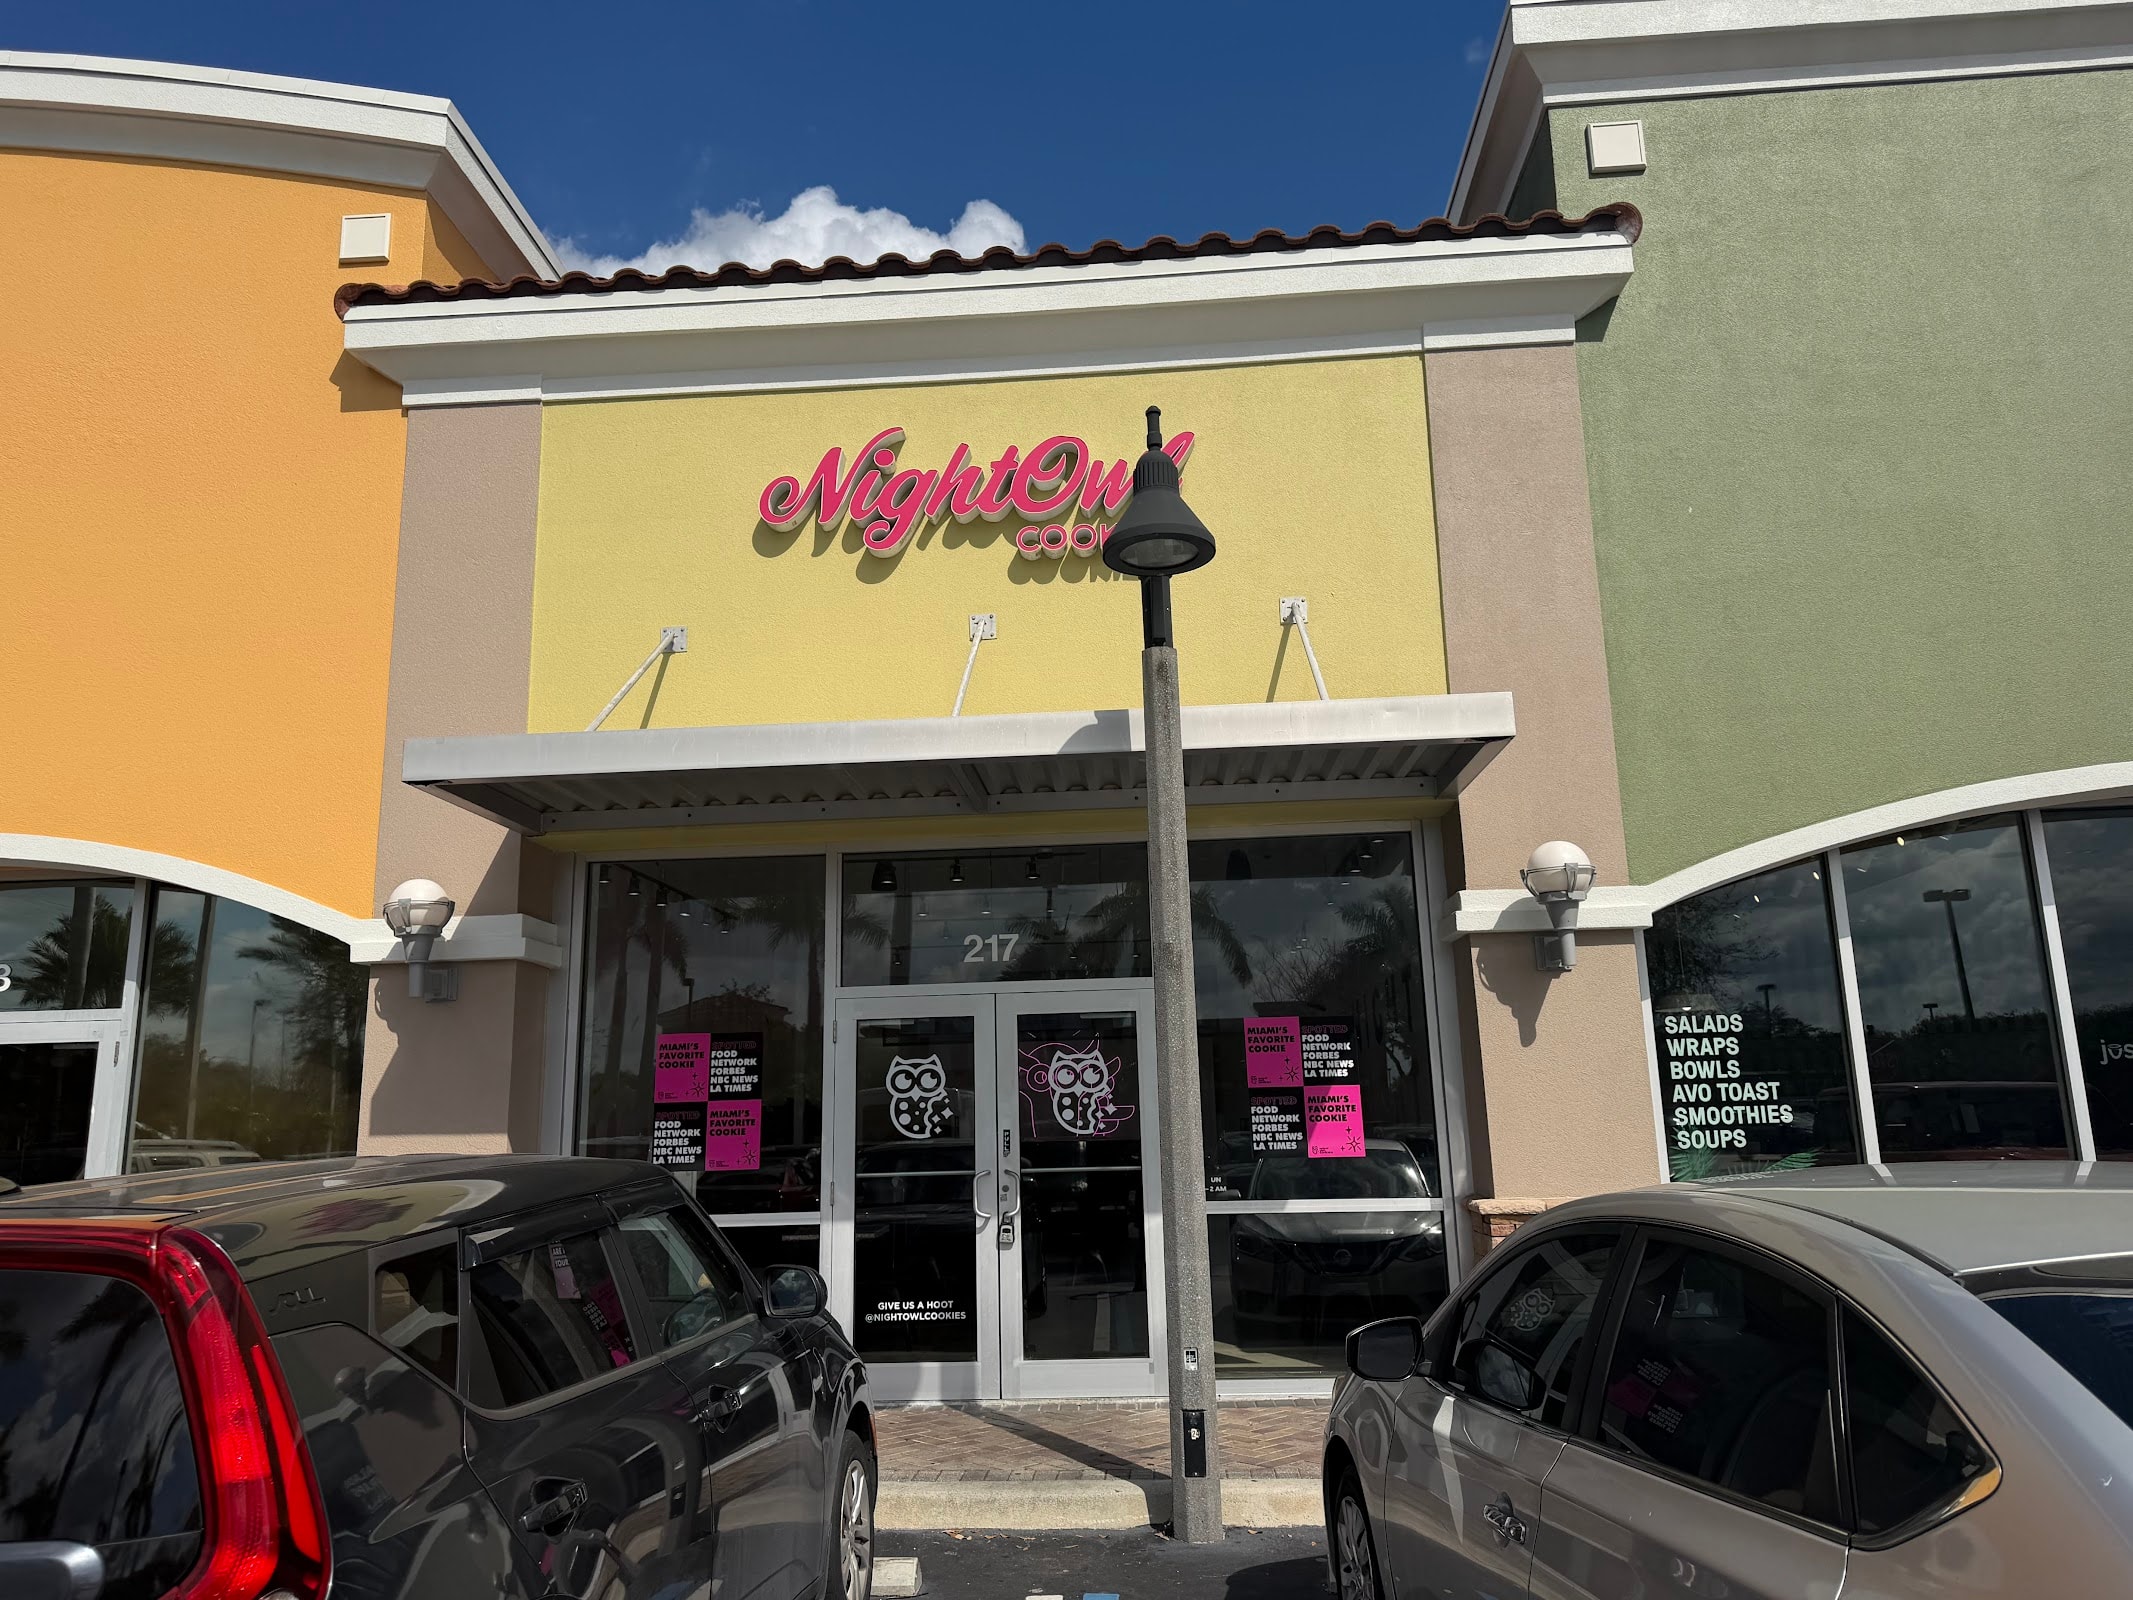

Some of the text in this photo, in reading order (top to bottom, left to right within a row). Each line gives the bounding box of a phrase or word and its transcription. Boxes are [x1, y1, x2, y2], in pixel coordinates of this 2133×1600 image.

[963, 933, 1019, 963] 217
[1665, 1014, 1743, 1034] SALADS
[1302, 1042, 1351, 1050] NETWORK
[1666, 1037, 1739, 1056] WRAPS
[1303, 1052, 1340, 1060] FORBES
[711, 1058, 757, 1066] NETWORK
[1327, 1060, 1354, 1068] NEWS
[711, 1067, 745, 1075] FORBES
[1670, 1060, 1740, 1079] BOWLS
[1673, 1082, 1780, 1102] AVO TOAST
[1309, 1105, 1356, 1113] FAVORITE
[1252, 1114, 1300, 1123] NETWORK
[1309, 1114, 1347, 1122] COOKIE
[1675, 1105, 1793, 1126] SMOOTHIES
[1252, 1124, 1288, 1132] FORBES
[654, 1129, 700, 1137] NETWORK
[1276, 1132, 1303, 1140] NEWS
[654, 1138, 689, 1146] FORBES
[1678, 1129, 1747, 1149] SOUPS
[1268, 1141, 1297, 1150] TIMES
[675, 1146, 701, 1155] NEWS
[865, 1312, 966, 1323] @NIGHTOWLCOOKIES
